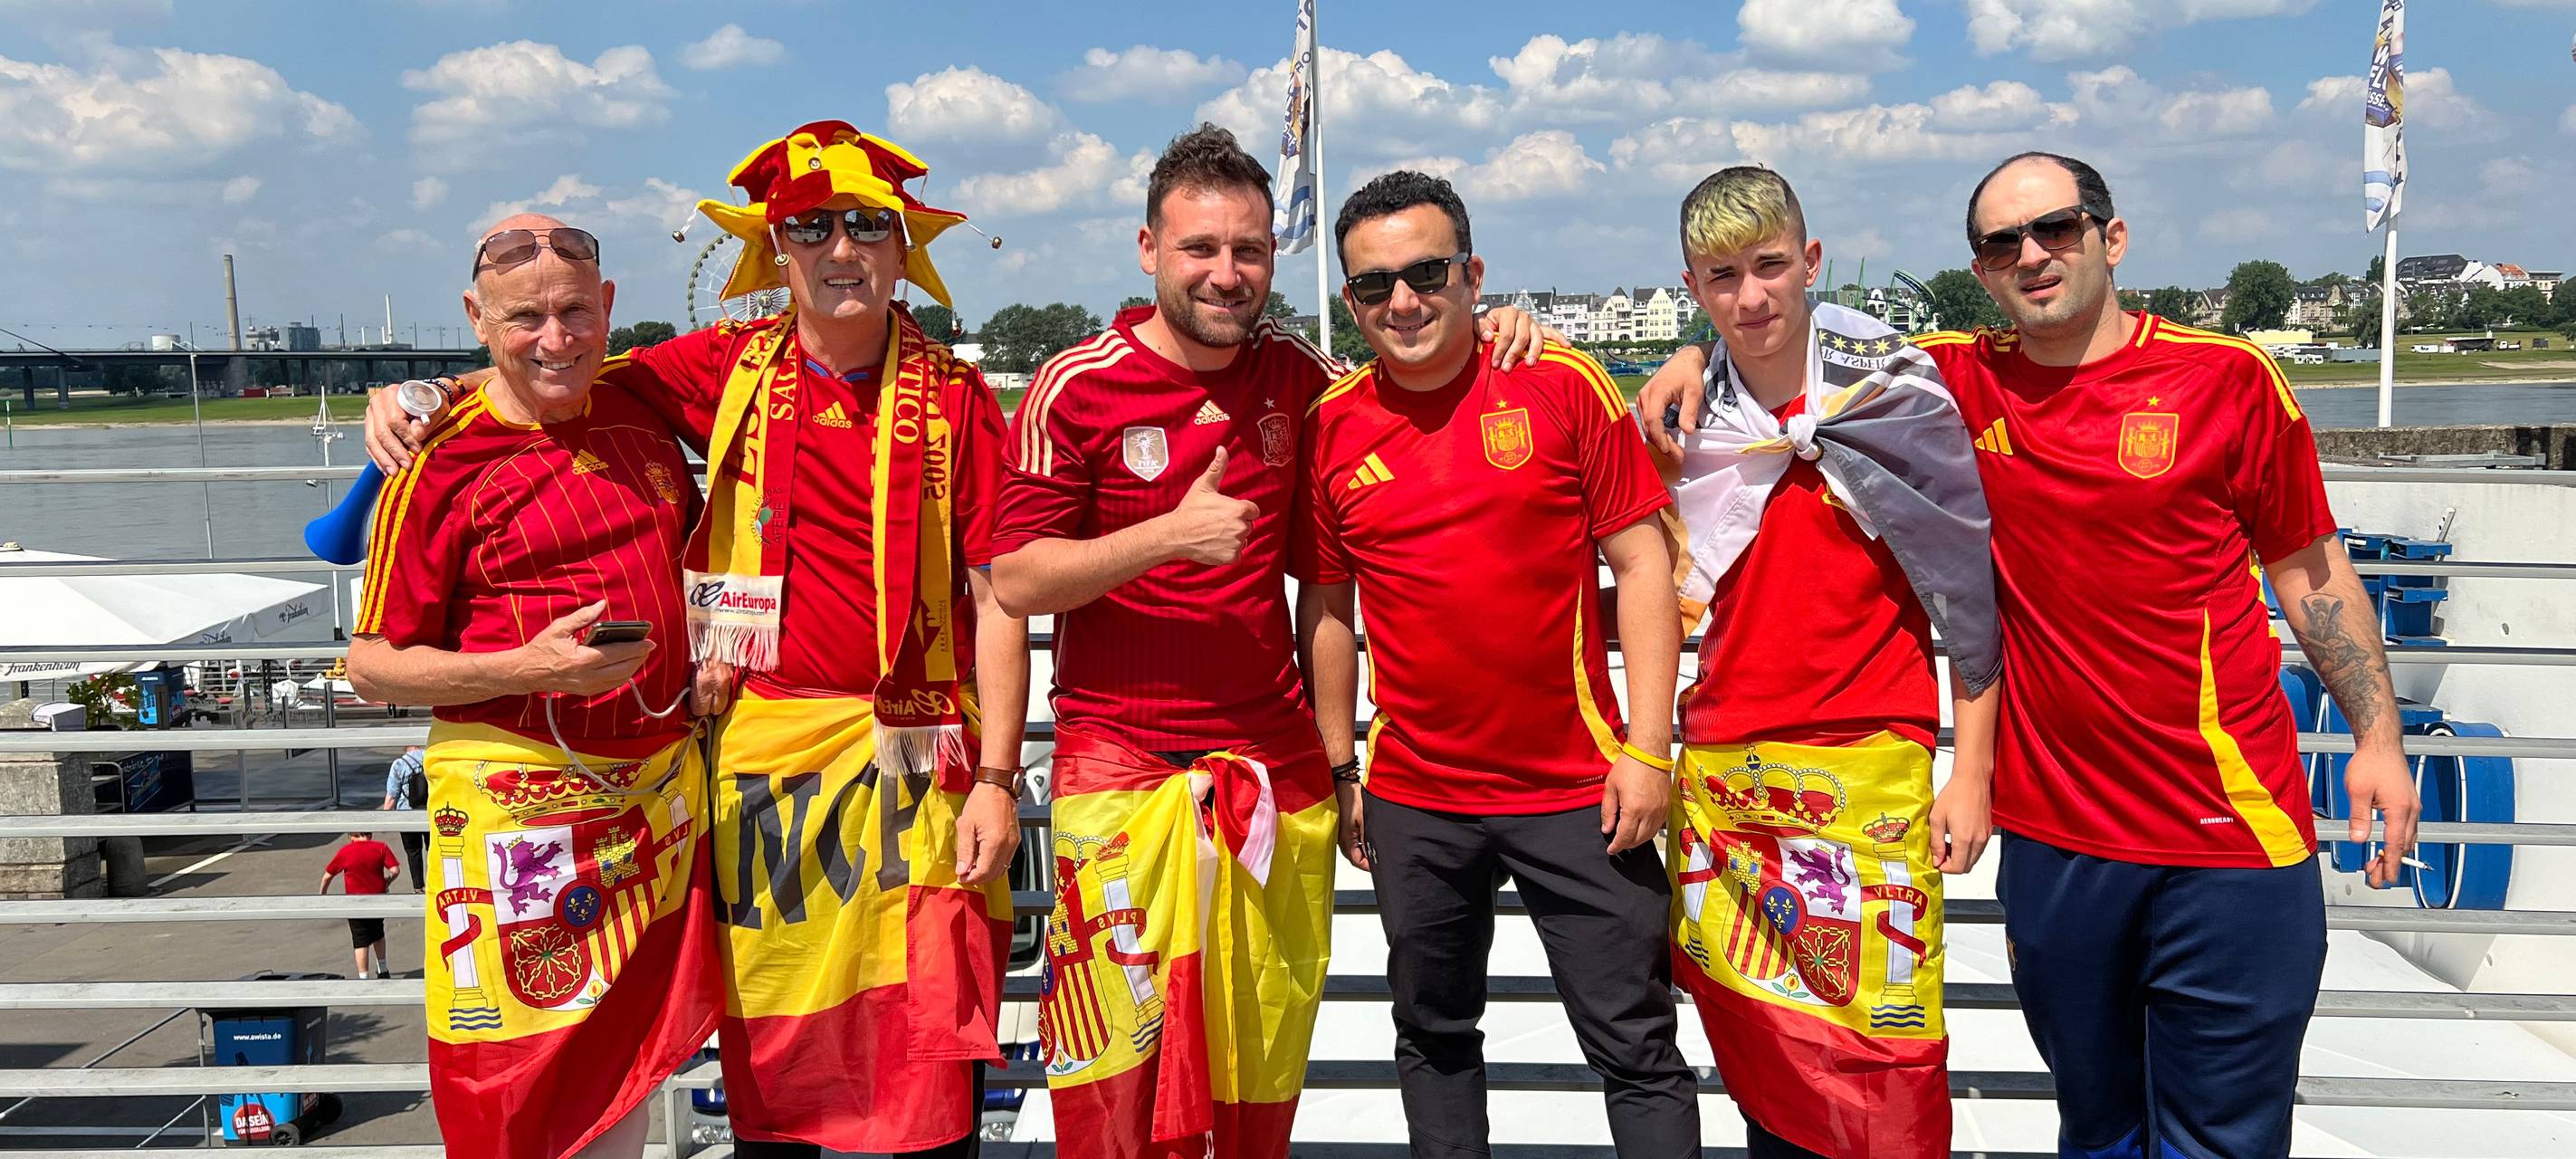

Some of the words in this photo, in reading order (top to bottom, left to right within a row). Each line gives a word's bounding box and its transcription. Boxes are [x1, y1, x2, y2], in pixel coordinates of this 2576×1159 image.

[812, 415, 852, 429] adidas
[1194, 413, 1231, 426] adidas
[719, 591, 776, 614] AirEuropa
[1874, 886, 1923, 906] VLTRA
[233, 1032, 281, 1041] www.awista.de
